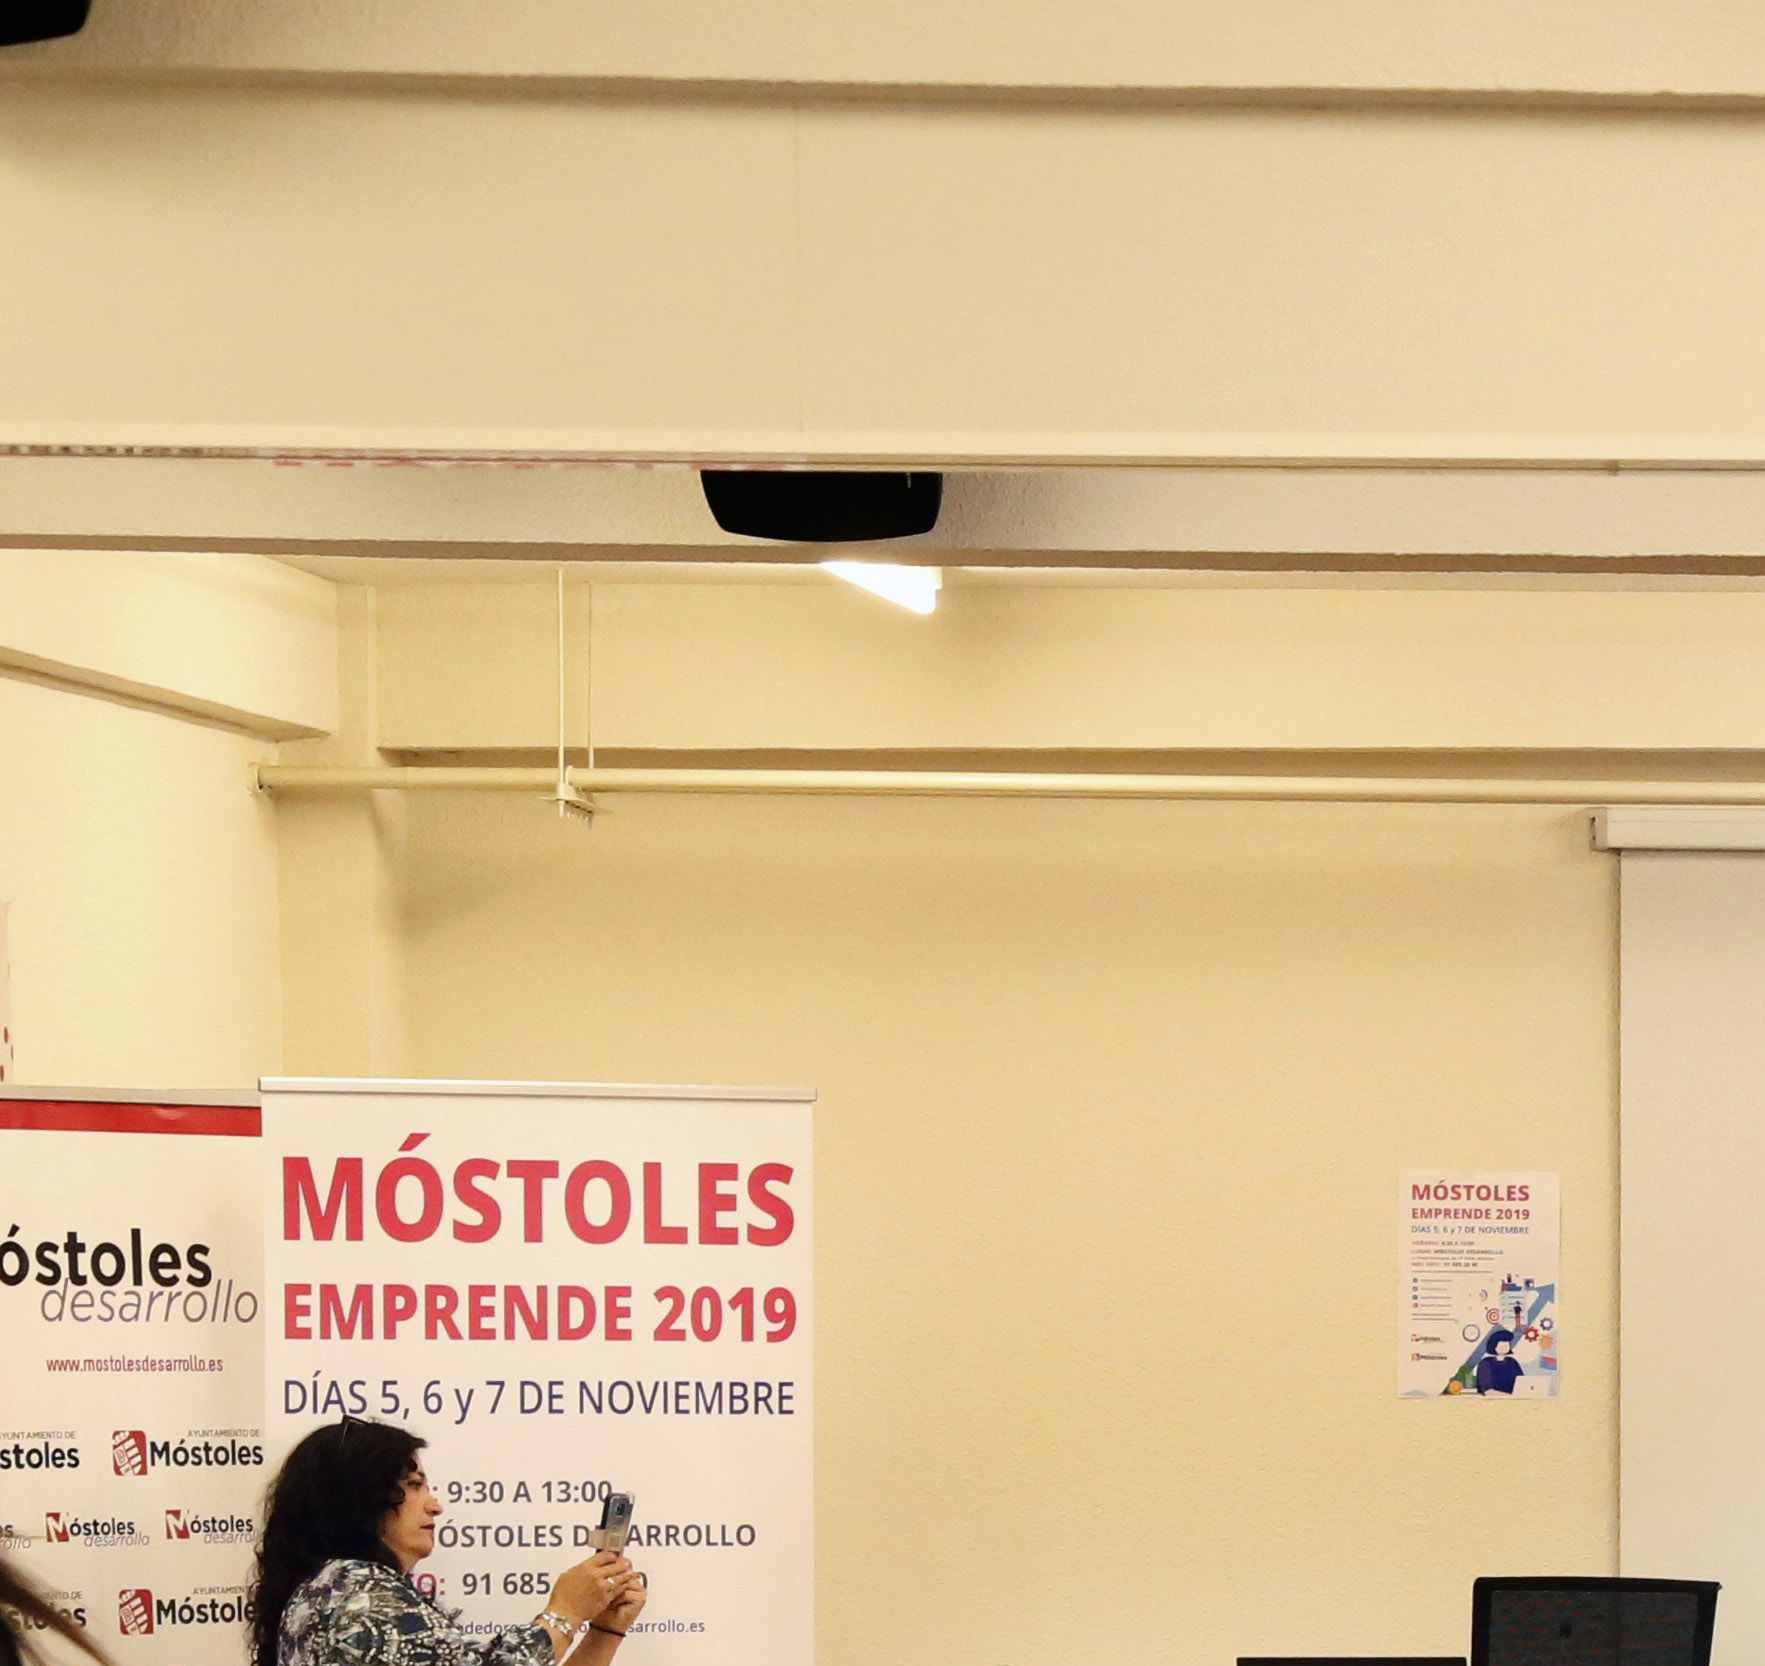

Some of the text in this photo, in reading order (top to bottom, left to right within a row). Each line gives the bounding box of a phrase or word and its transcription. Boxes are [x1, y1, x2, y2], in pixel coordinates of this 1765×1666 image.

[282, 1133, 794, 1246] MÓSTOLES
[1412, 1180, 1530, 1201] MÓSTOLES
[1411, 1208, 1530, 1220] EMPRENDE 2019
[1411, 1224, 1430, 1233] DÍAS
[1479, 1226, 1528, 1234] NOVIEMBRE
[41, 1278, 258, 1323] desarrollo
[283, 1283, 797, 1343] EMPRENDE 2019
[46, 1355, 223, 1372] www.mostolesdesarrollo.es
[284, 1370, 794, 1424] DÍAS 5, 6 y 7 DE NOVIEMBRE
[65, 1431, 76, 1439] DE
[250, 1429, 260, 1437] DE
[151, 1439, 263, 1466] Móstoles
[447, 1481, 612, 1503] 9:30 A 13:00
[84, 1531, 149, 1547] desarrollo
[438, 1519, 756, 1548] ÓSTOLES DARROLLO
[462, 1573, 491, 1595] 91
[503, 1573, 550, 1595] 685
